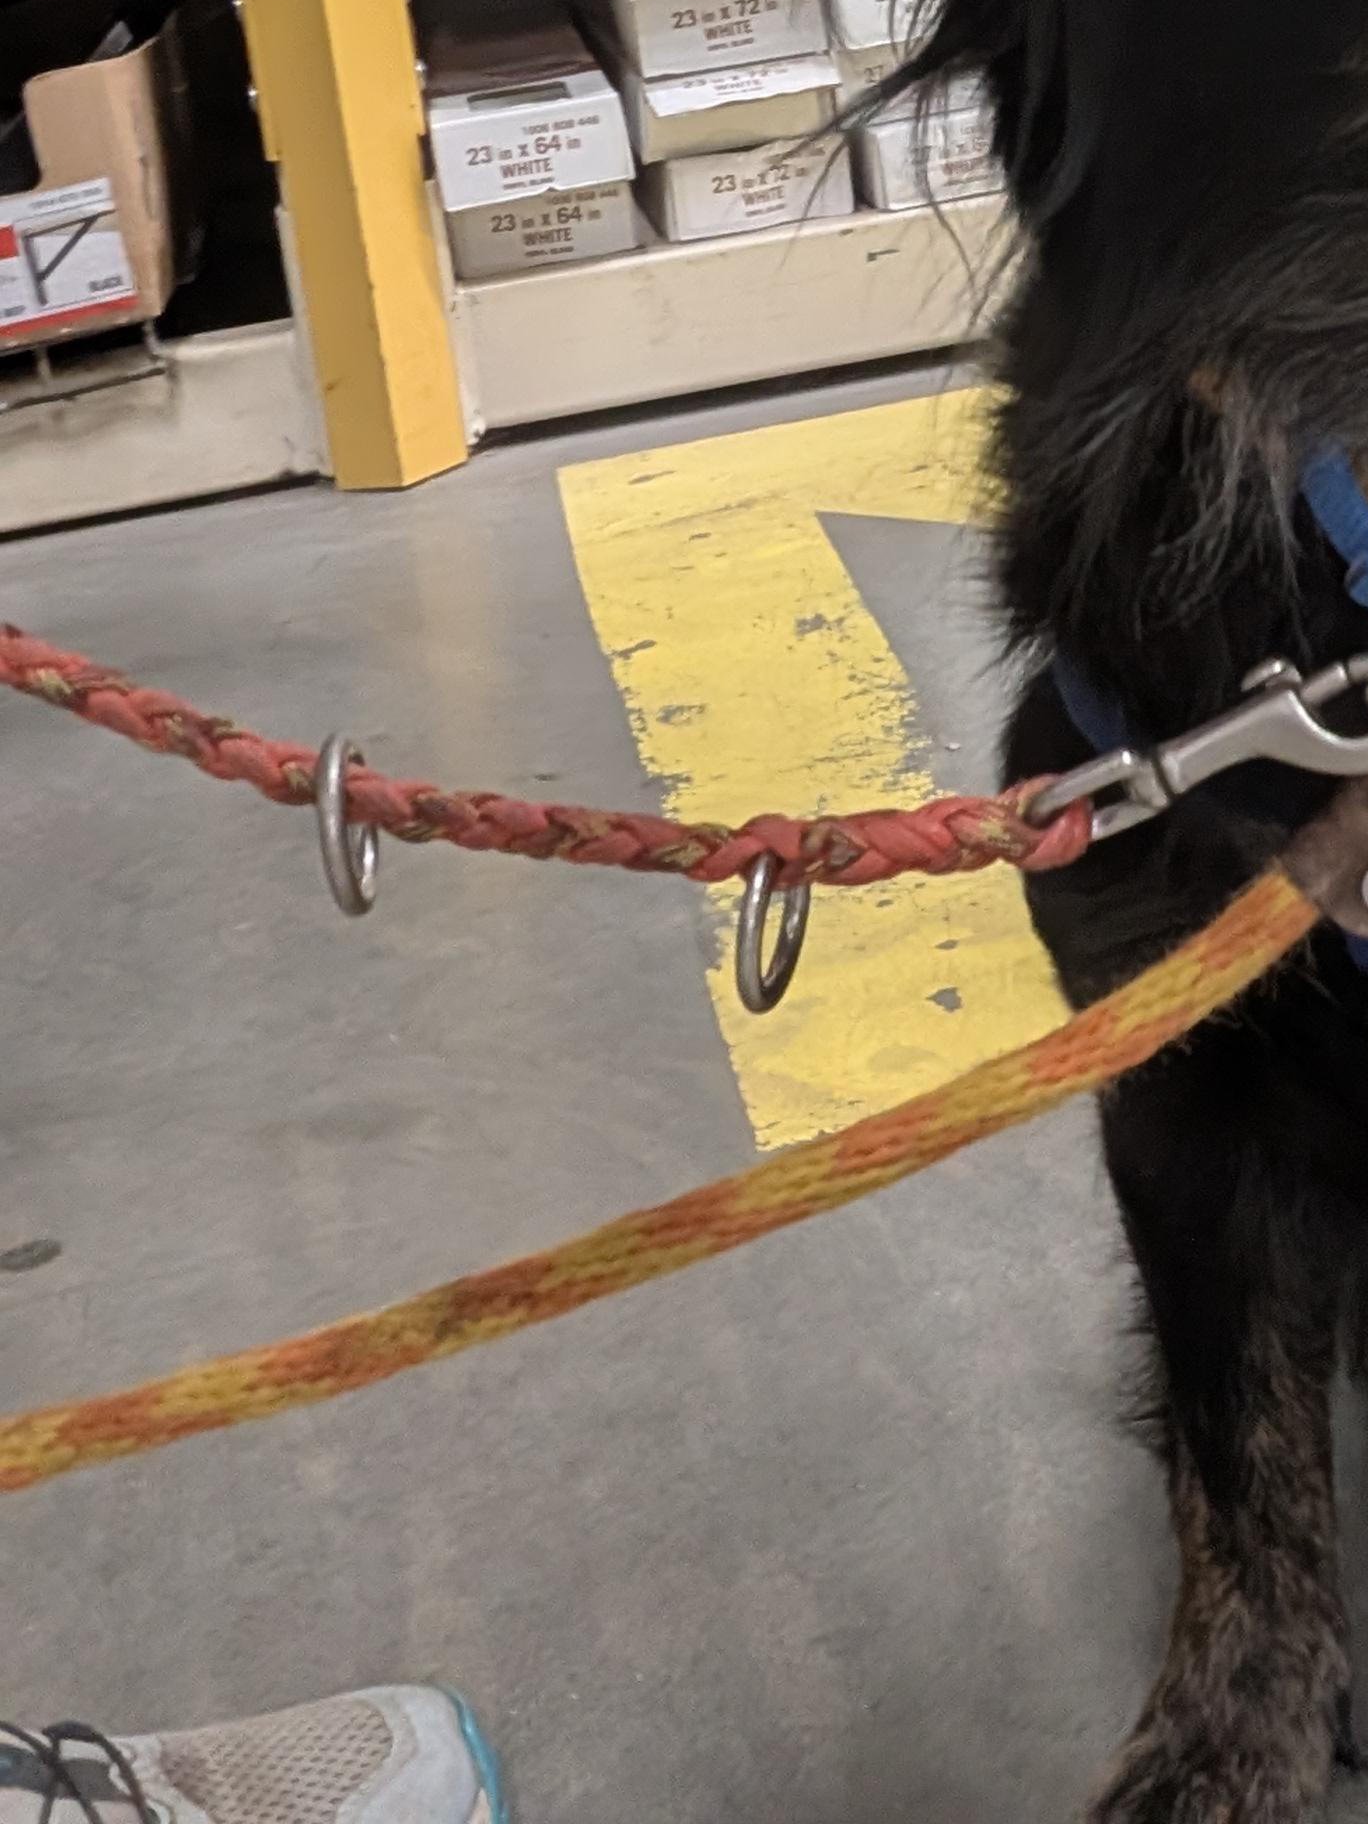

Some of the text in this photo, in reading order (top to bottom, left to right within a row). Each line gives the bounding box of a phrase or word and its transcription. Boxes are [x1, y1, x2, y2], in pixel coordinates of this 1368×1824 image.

[466, 146, 492, 166] 23
[498, 147, 512, 160] in
[534, 136, 561, 154] 64
[567, 137, 581, 149] in
[500, 159, 553, 177] WHITE
